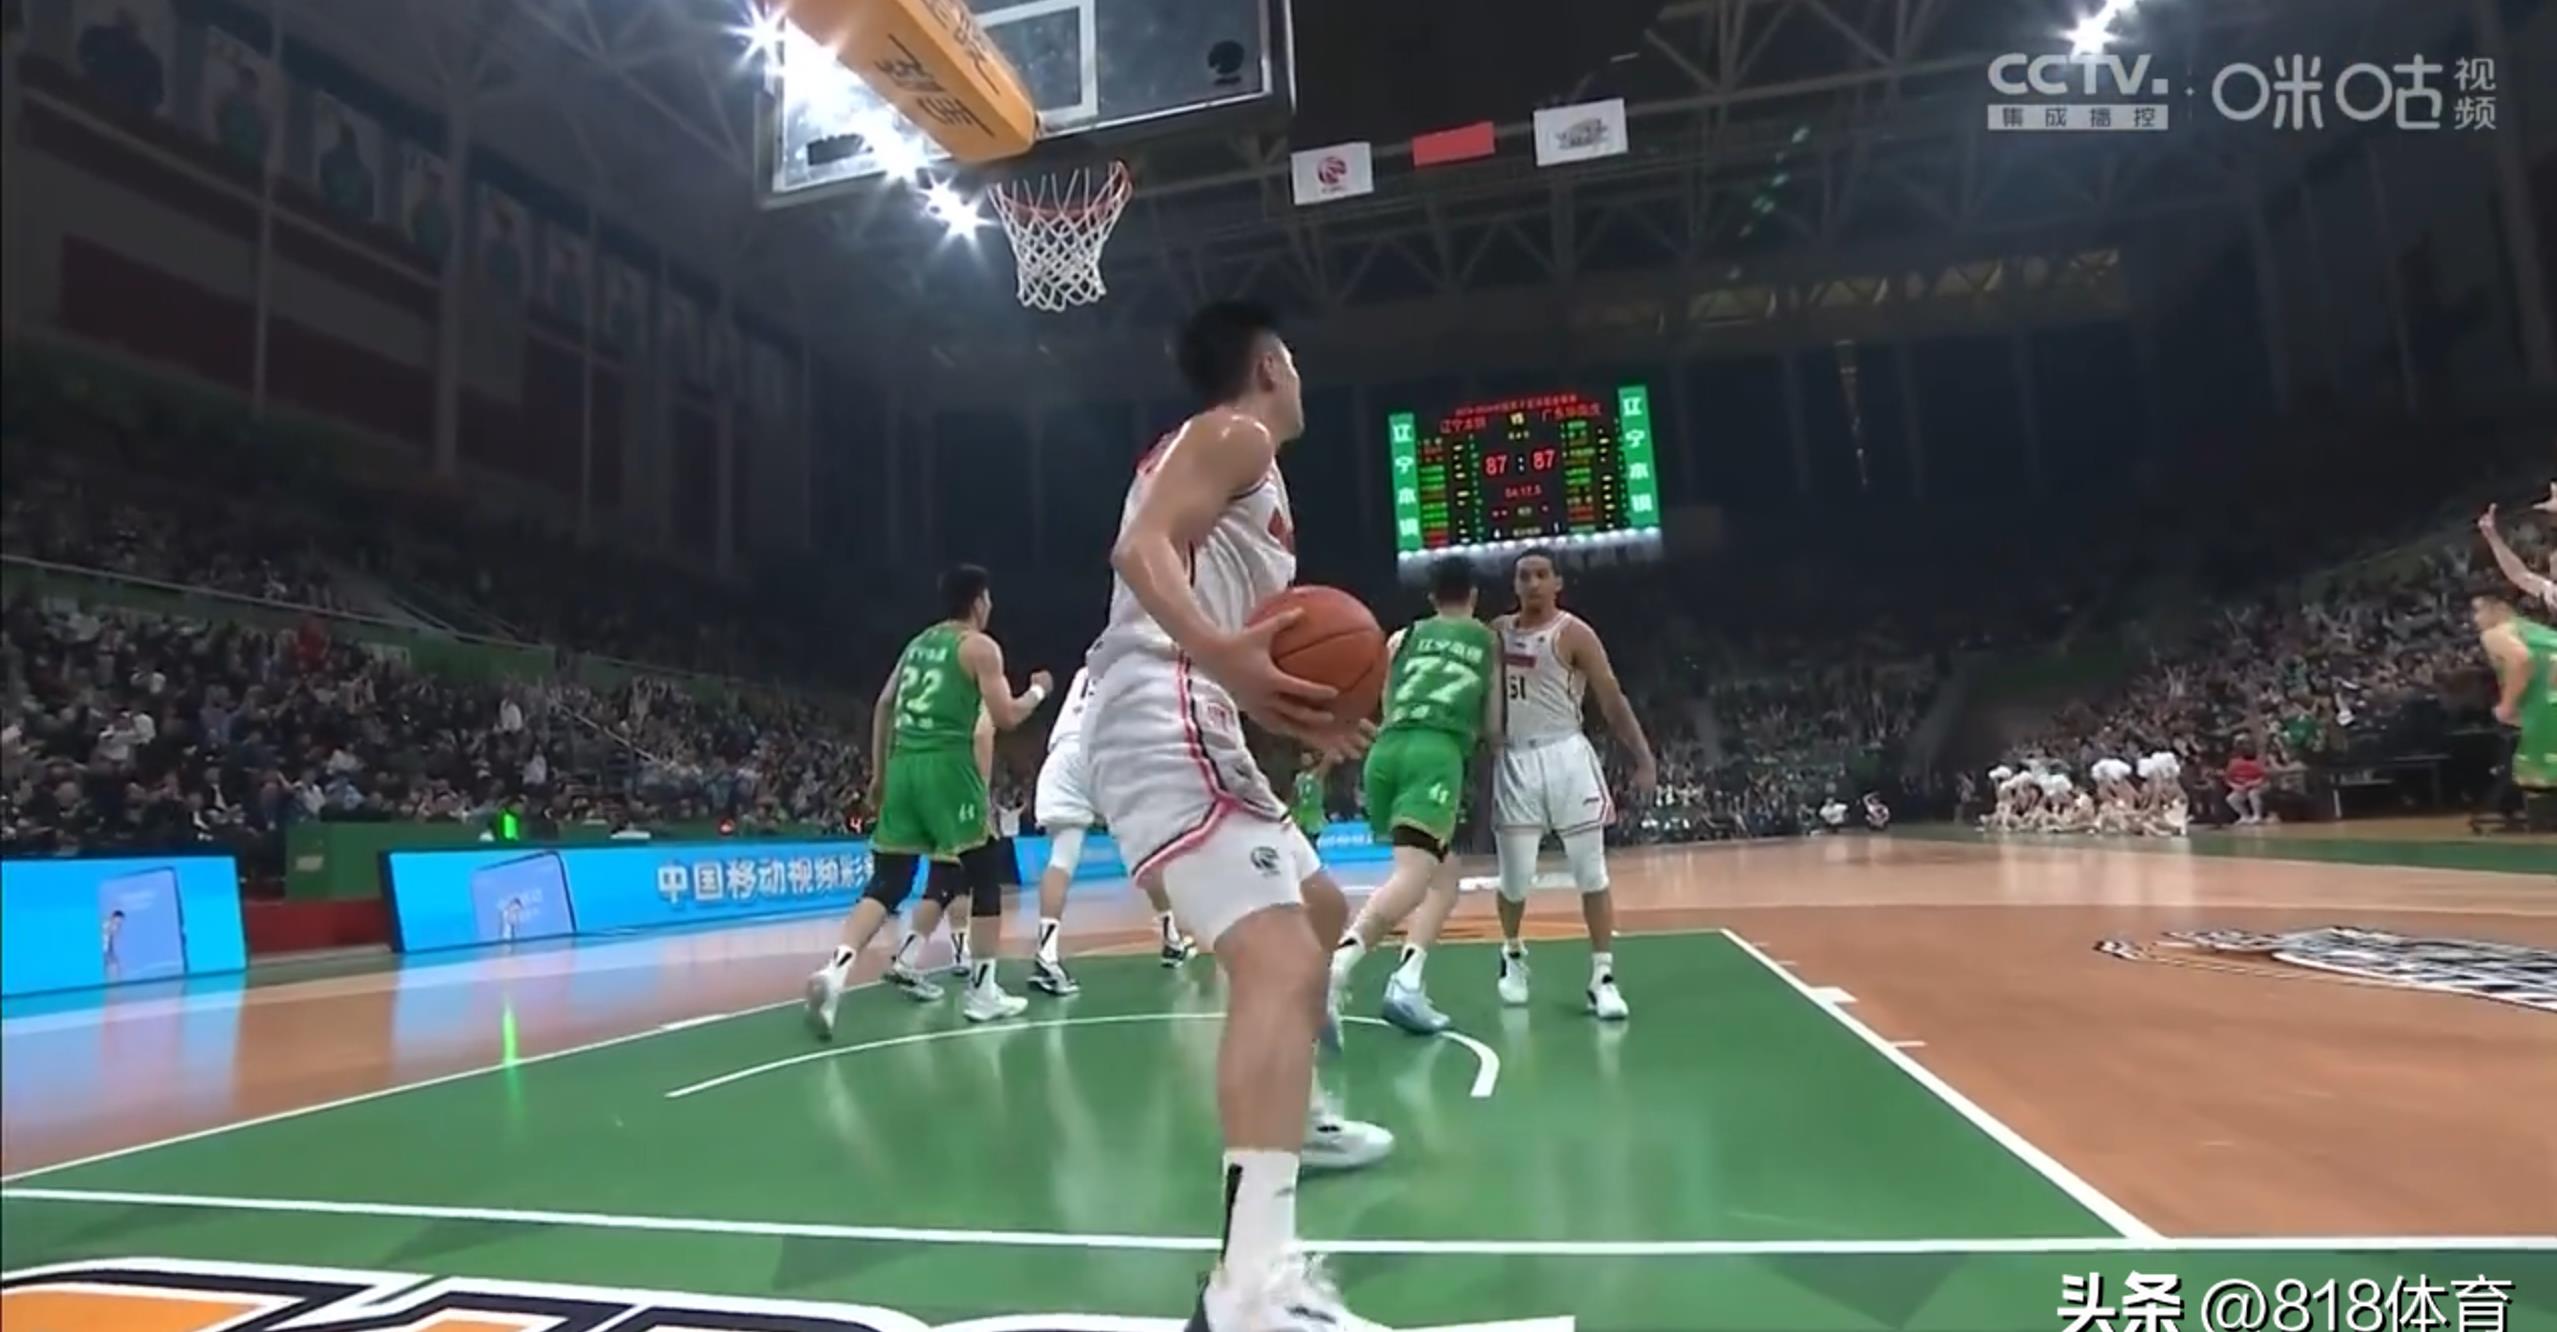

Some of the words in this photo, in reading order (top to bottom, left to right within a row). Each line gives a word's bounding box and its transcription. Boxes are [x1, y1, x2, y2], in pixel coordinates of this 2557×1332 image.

[1485, 455, 1507, 475] 87
[1533, 450, 1554, 470] 87
[901, 665, 943, 713] 22
[1396, 656, 1480, 703] 77
